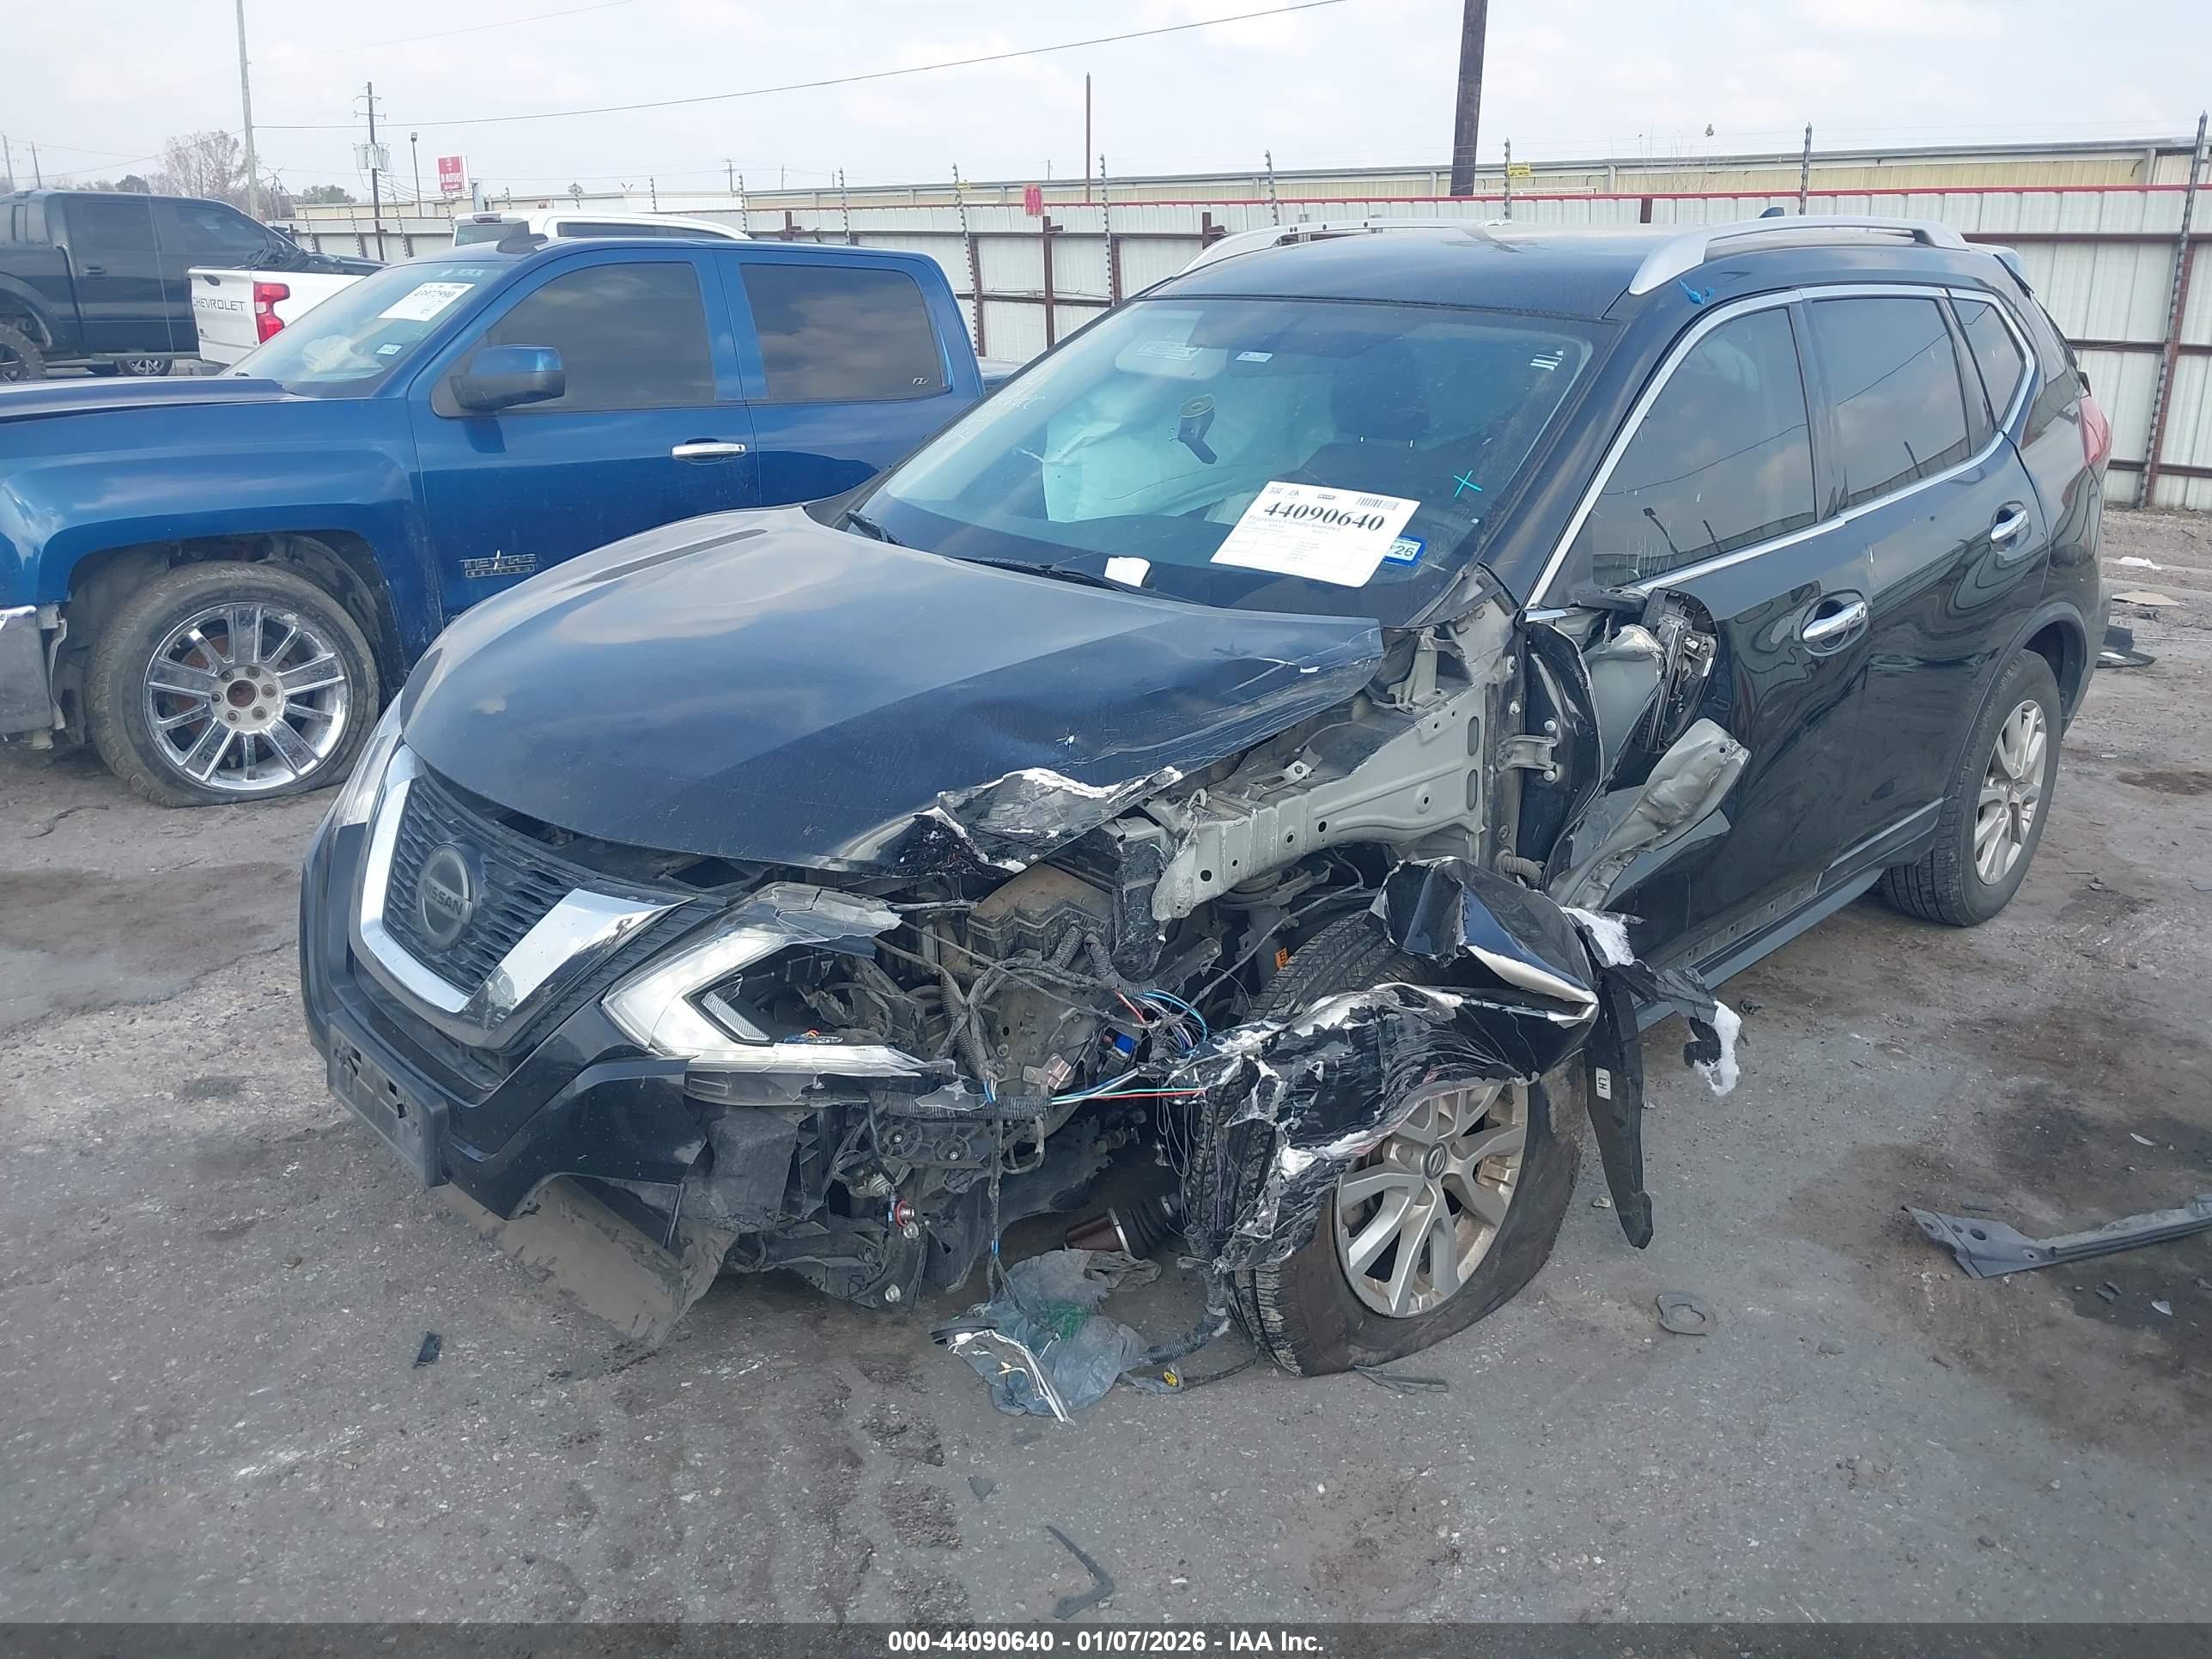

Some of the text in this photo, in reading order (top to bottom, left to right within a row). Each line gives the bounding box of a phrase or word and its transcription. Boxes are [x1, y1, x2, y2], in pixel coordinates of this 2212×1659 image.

[192, 297, 246, 311] CHEVROLET
[1264, 501, 1385, 531] 44090640
[1394, 545, 1415, 556] 26
[459, 552, 537, 570] TEXAS
[424, 878, 463, 915] NISSAN
[1598, 1077, 1607, 1090] LH
